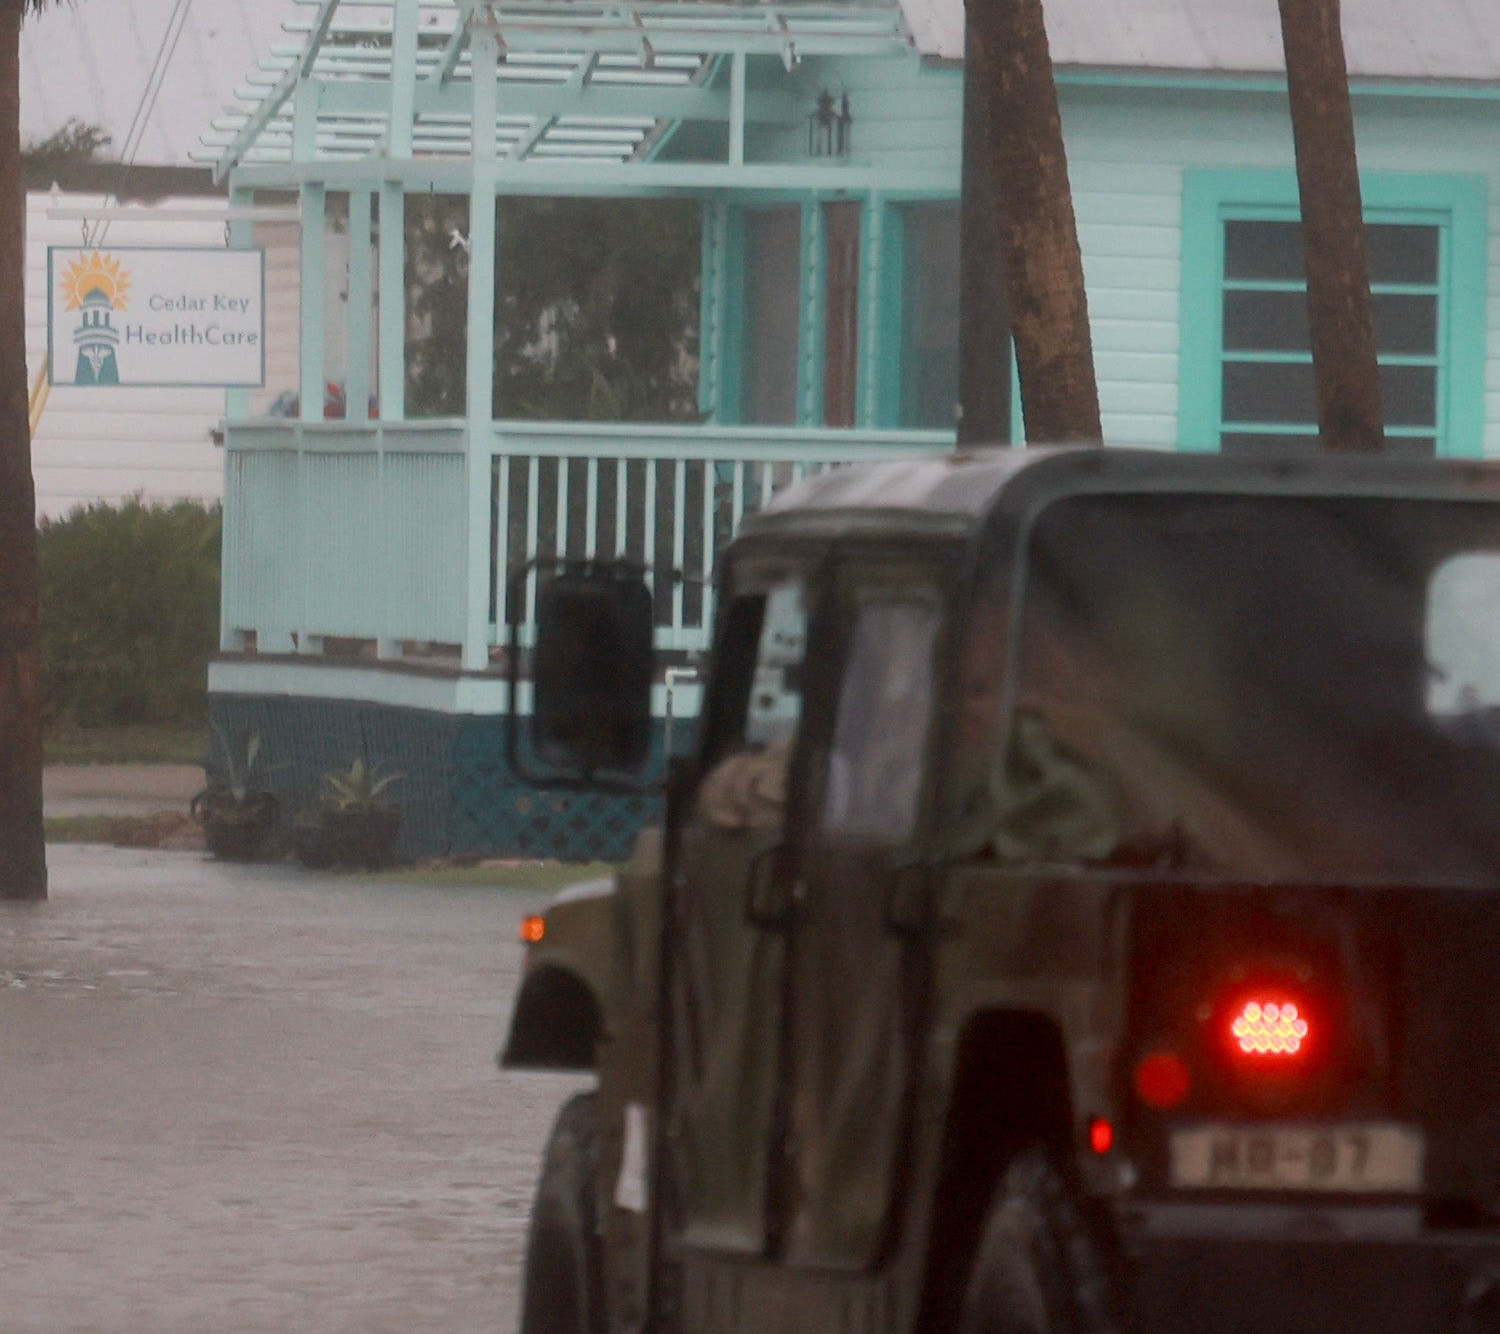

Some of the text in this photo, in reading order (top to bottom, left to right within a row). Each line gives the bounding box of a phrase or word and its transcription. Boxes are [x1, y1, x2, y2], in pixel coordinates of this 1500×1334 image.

[149, 294, 250, 314] Cedar Key
[125, 324, 258, 346] HealthCare
